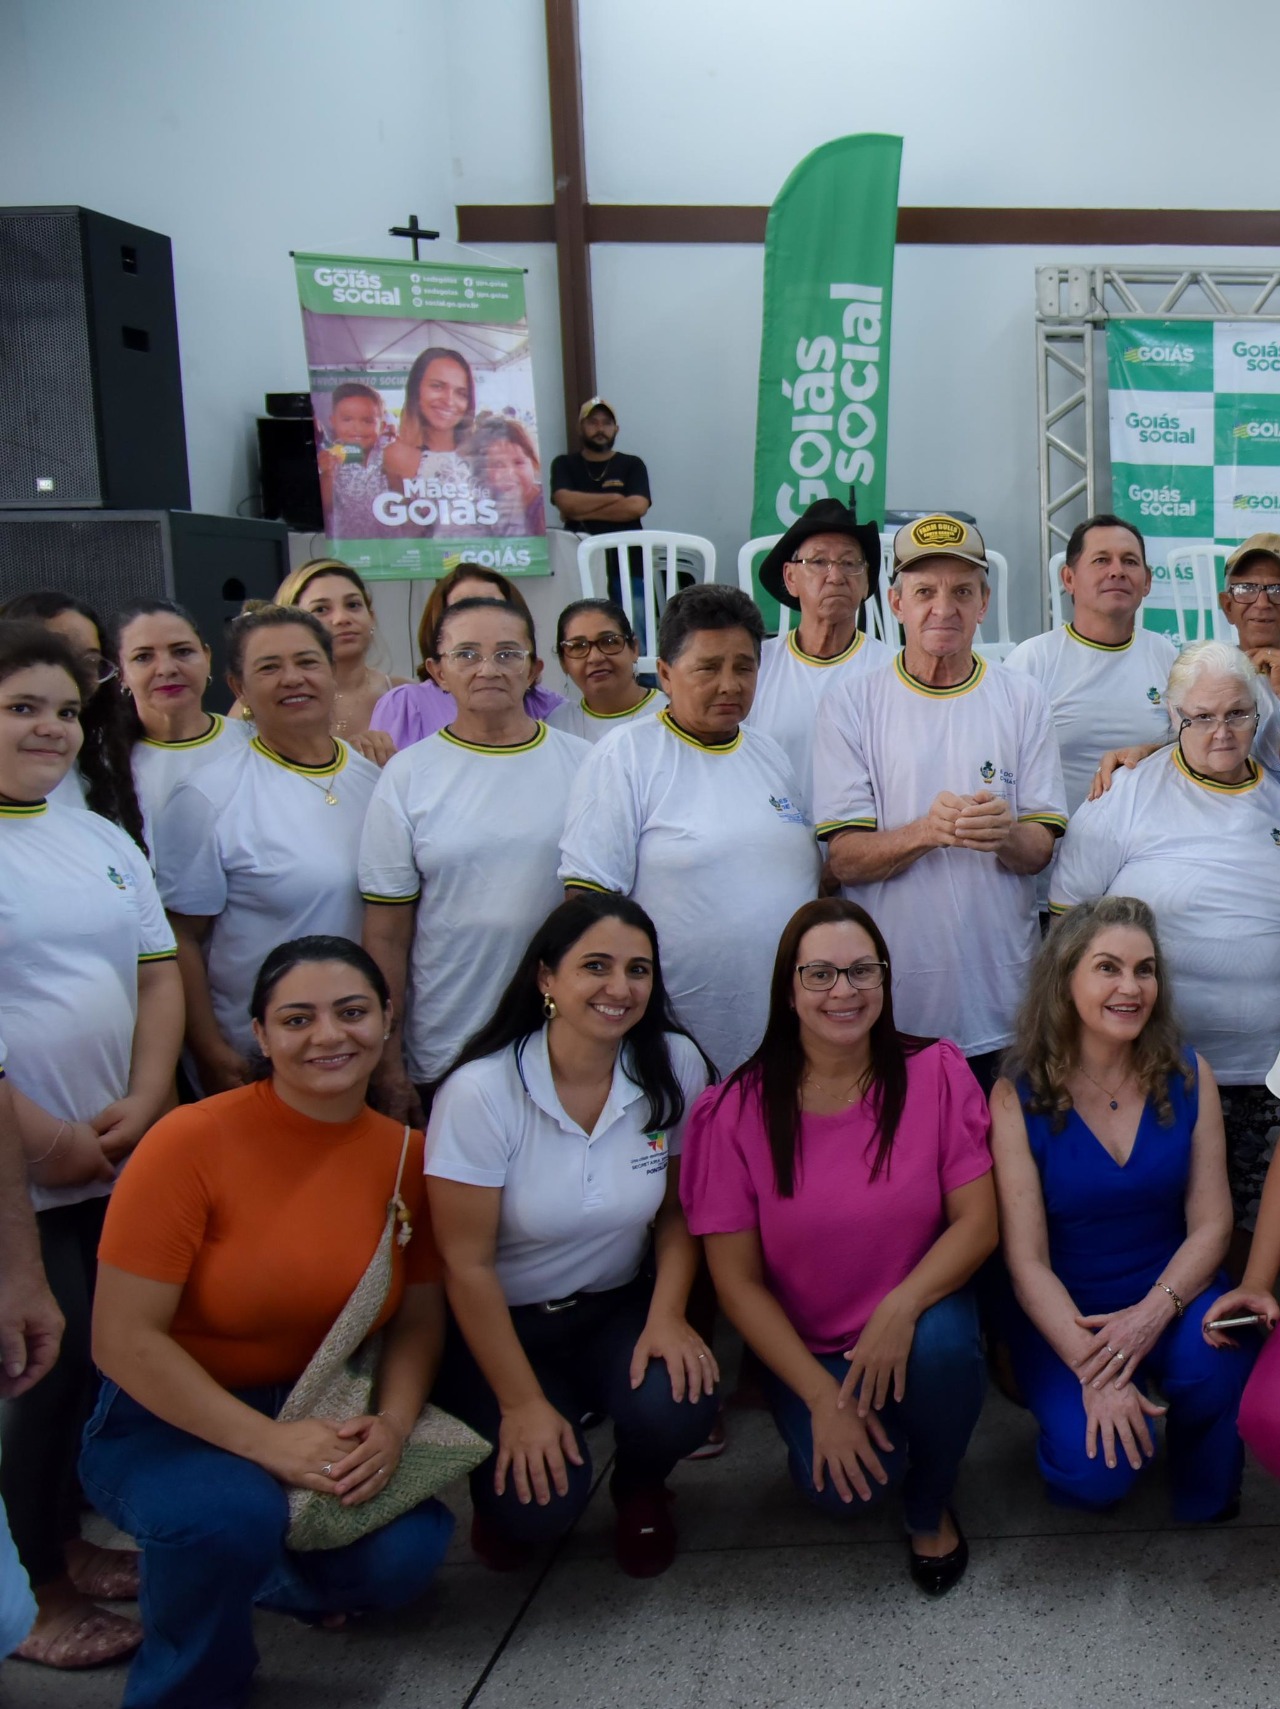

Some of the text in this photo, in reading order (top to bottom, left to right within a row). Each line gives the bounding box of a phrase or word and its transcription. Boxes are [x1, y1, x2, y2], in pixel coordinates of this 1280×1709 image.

[314, 268, 382, 289] Goiás
[333, 287, 400, 306] social
[1138, 344, 1195, 362] GOIÁS
[830, 283, 883, 486] social
[1126, 412, 1180, 430] Goiás
[1140, 428, 1195, 444] social
[1128, 484, 1181, 502] Goiás
[372, 492, 499, 526] Goiás
[1140, 500, 1196, 516] social
[460, 546, 531, 567] GOIÁS
[1150, 563, 1194, 580] OIÁS
